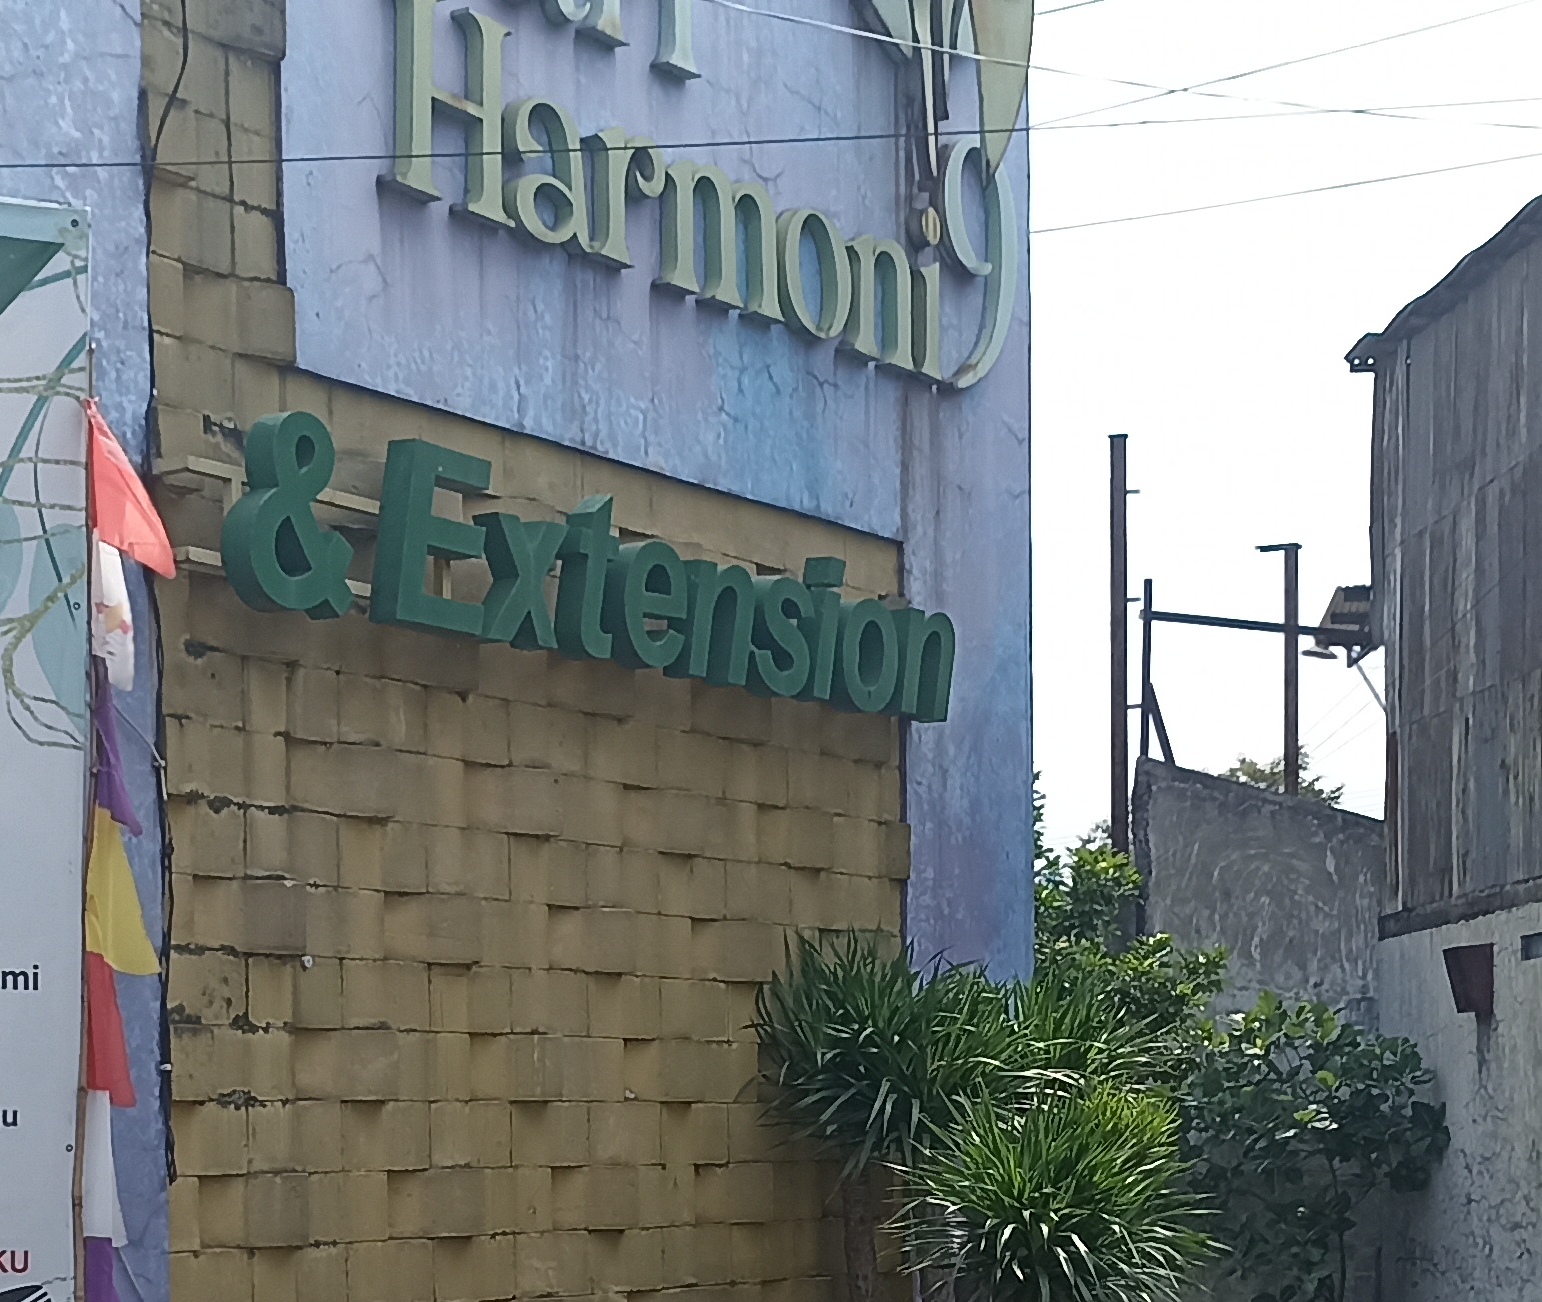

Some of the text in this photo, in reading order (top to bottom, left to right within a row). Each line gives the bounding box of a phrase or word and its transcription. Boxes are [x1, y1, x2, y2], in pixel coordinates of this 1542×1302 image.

[376, 0, 944, 383] Harmoni
[220, 411, 956, 723] & Extension
